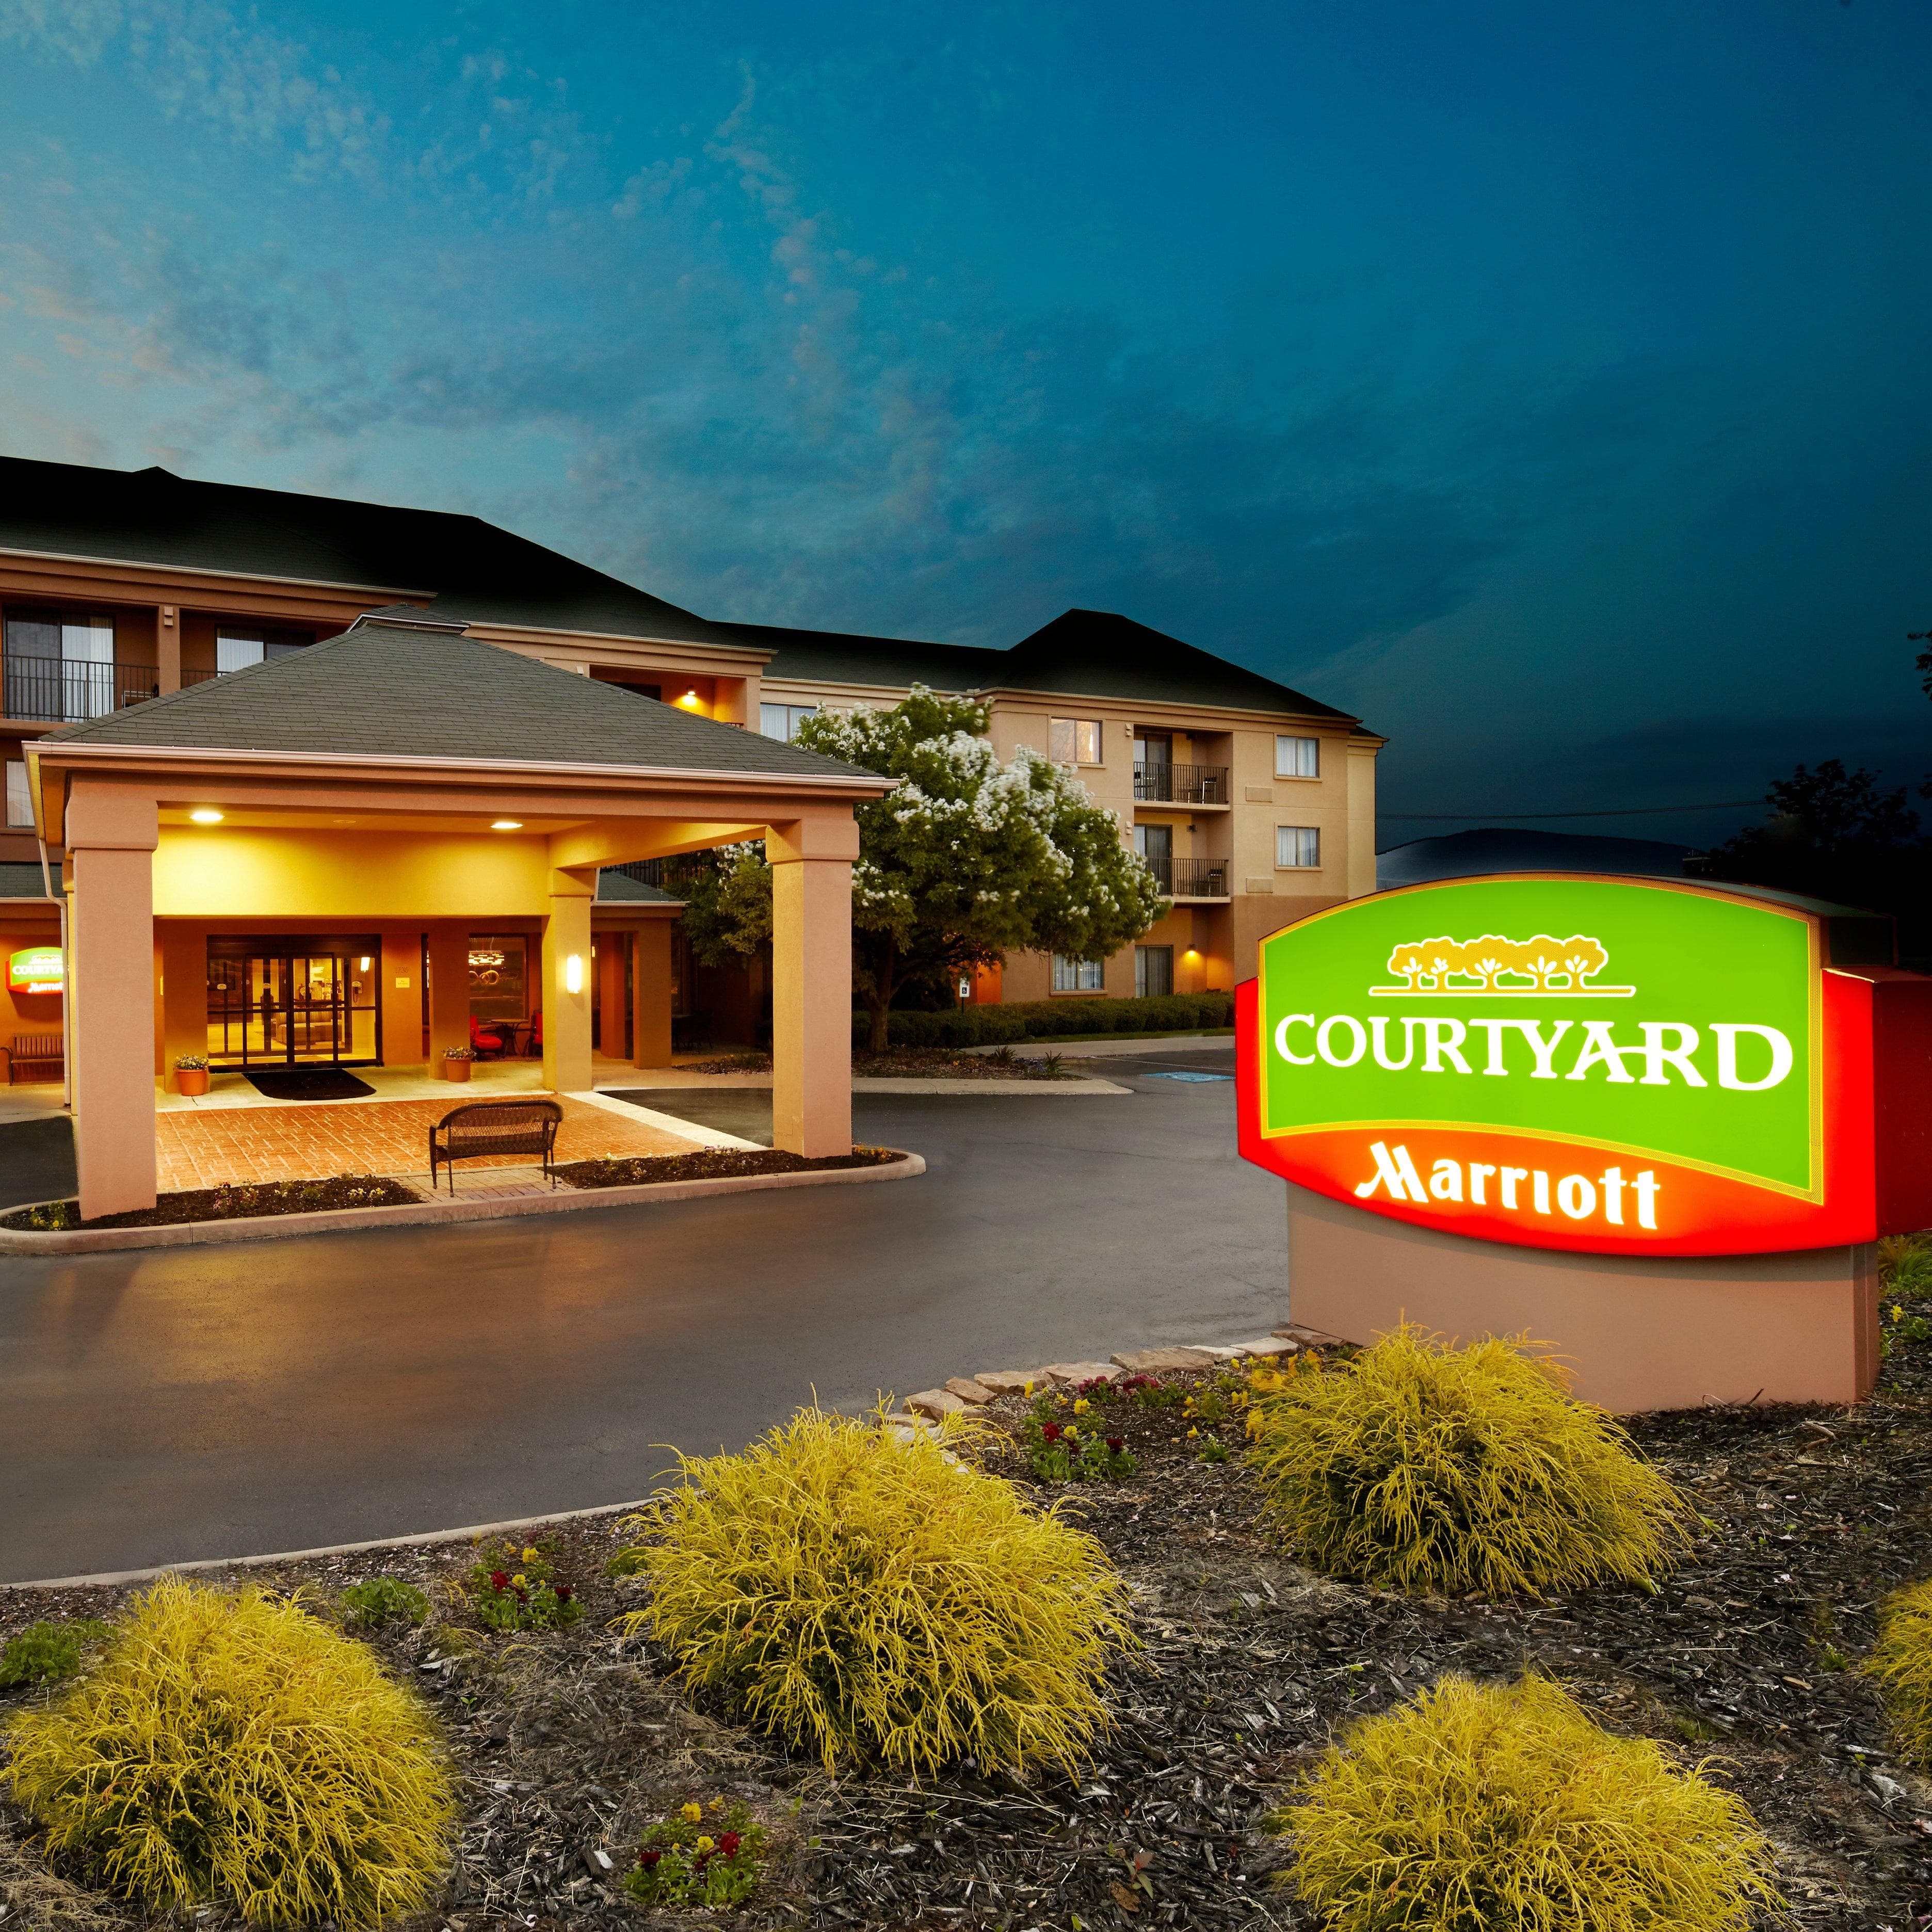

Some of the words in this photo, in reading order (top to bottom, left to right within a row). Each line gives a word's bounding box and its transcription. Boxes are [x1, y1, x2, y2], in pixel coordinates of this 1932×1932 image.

[12, 965, 63, 974] COURTYA
[1275, 1013, 1793, 1091] COURTYARD
[1354, 1141, 1661, 1230] Marriott
